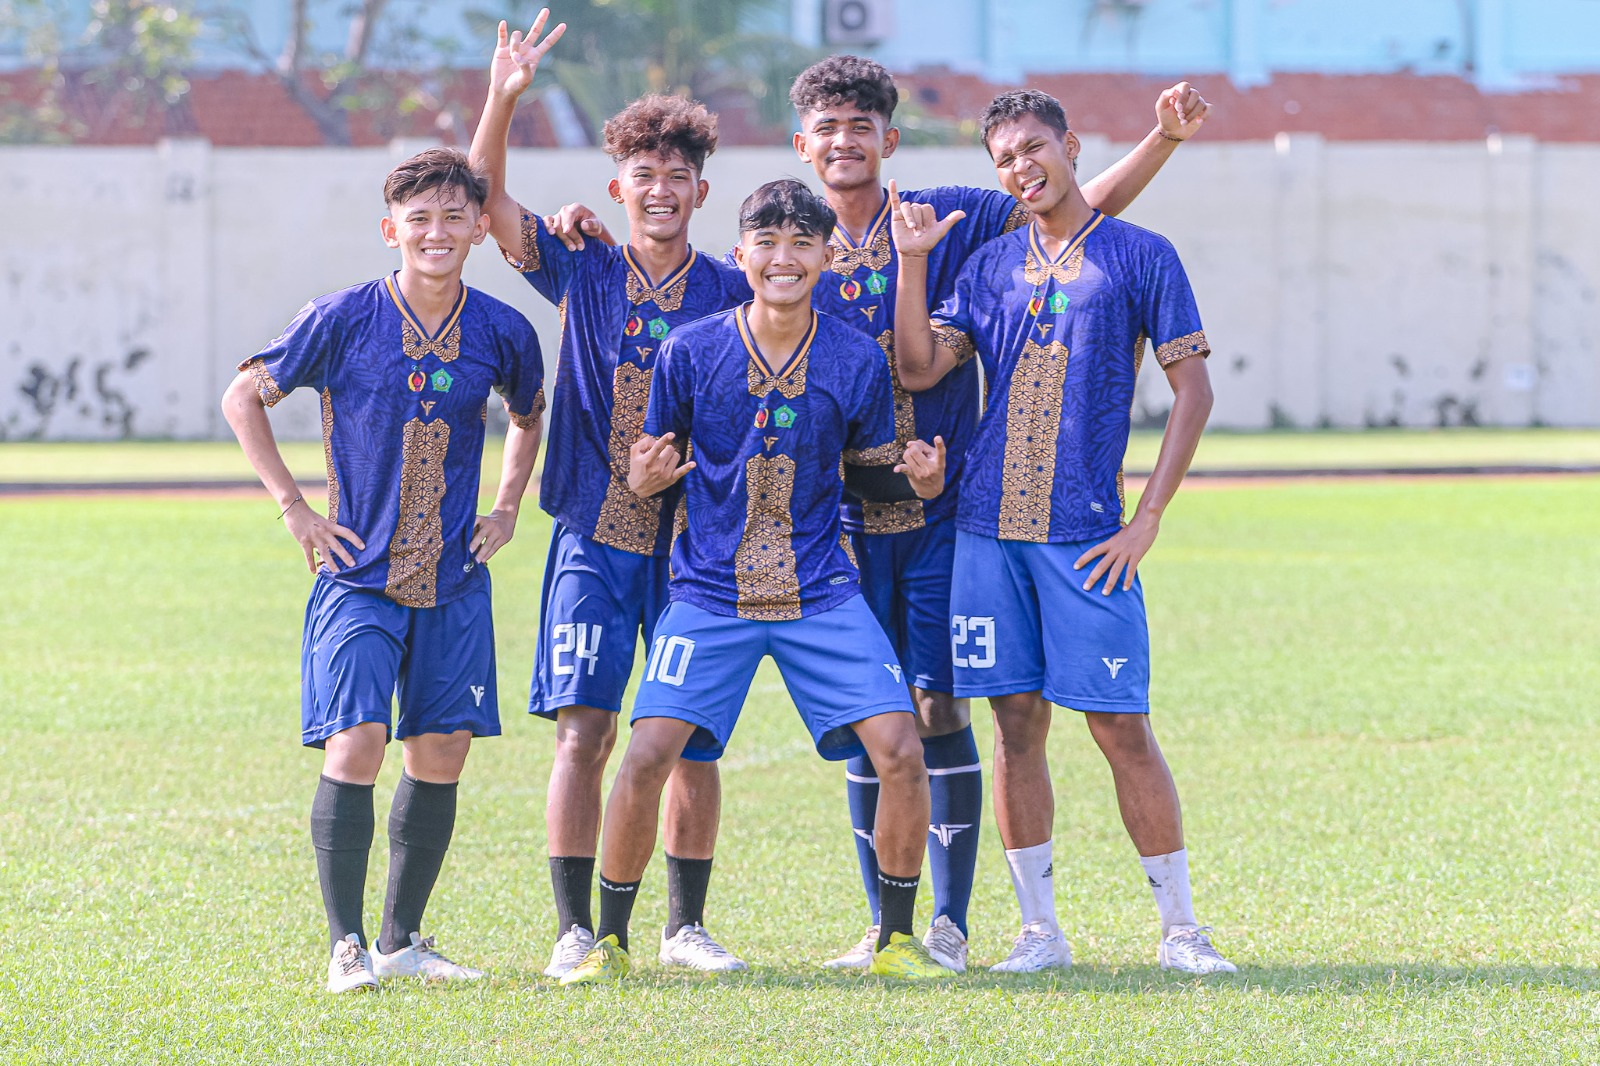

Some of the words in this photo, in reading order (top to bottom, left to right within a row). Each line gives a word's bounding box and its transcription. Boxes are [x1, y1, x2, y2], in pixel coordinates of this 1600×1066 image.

[552, 622, 603, 676] 24
[645, 634, 696, 687] 10
[951, 614, 996, 669] 23
